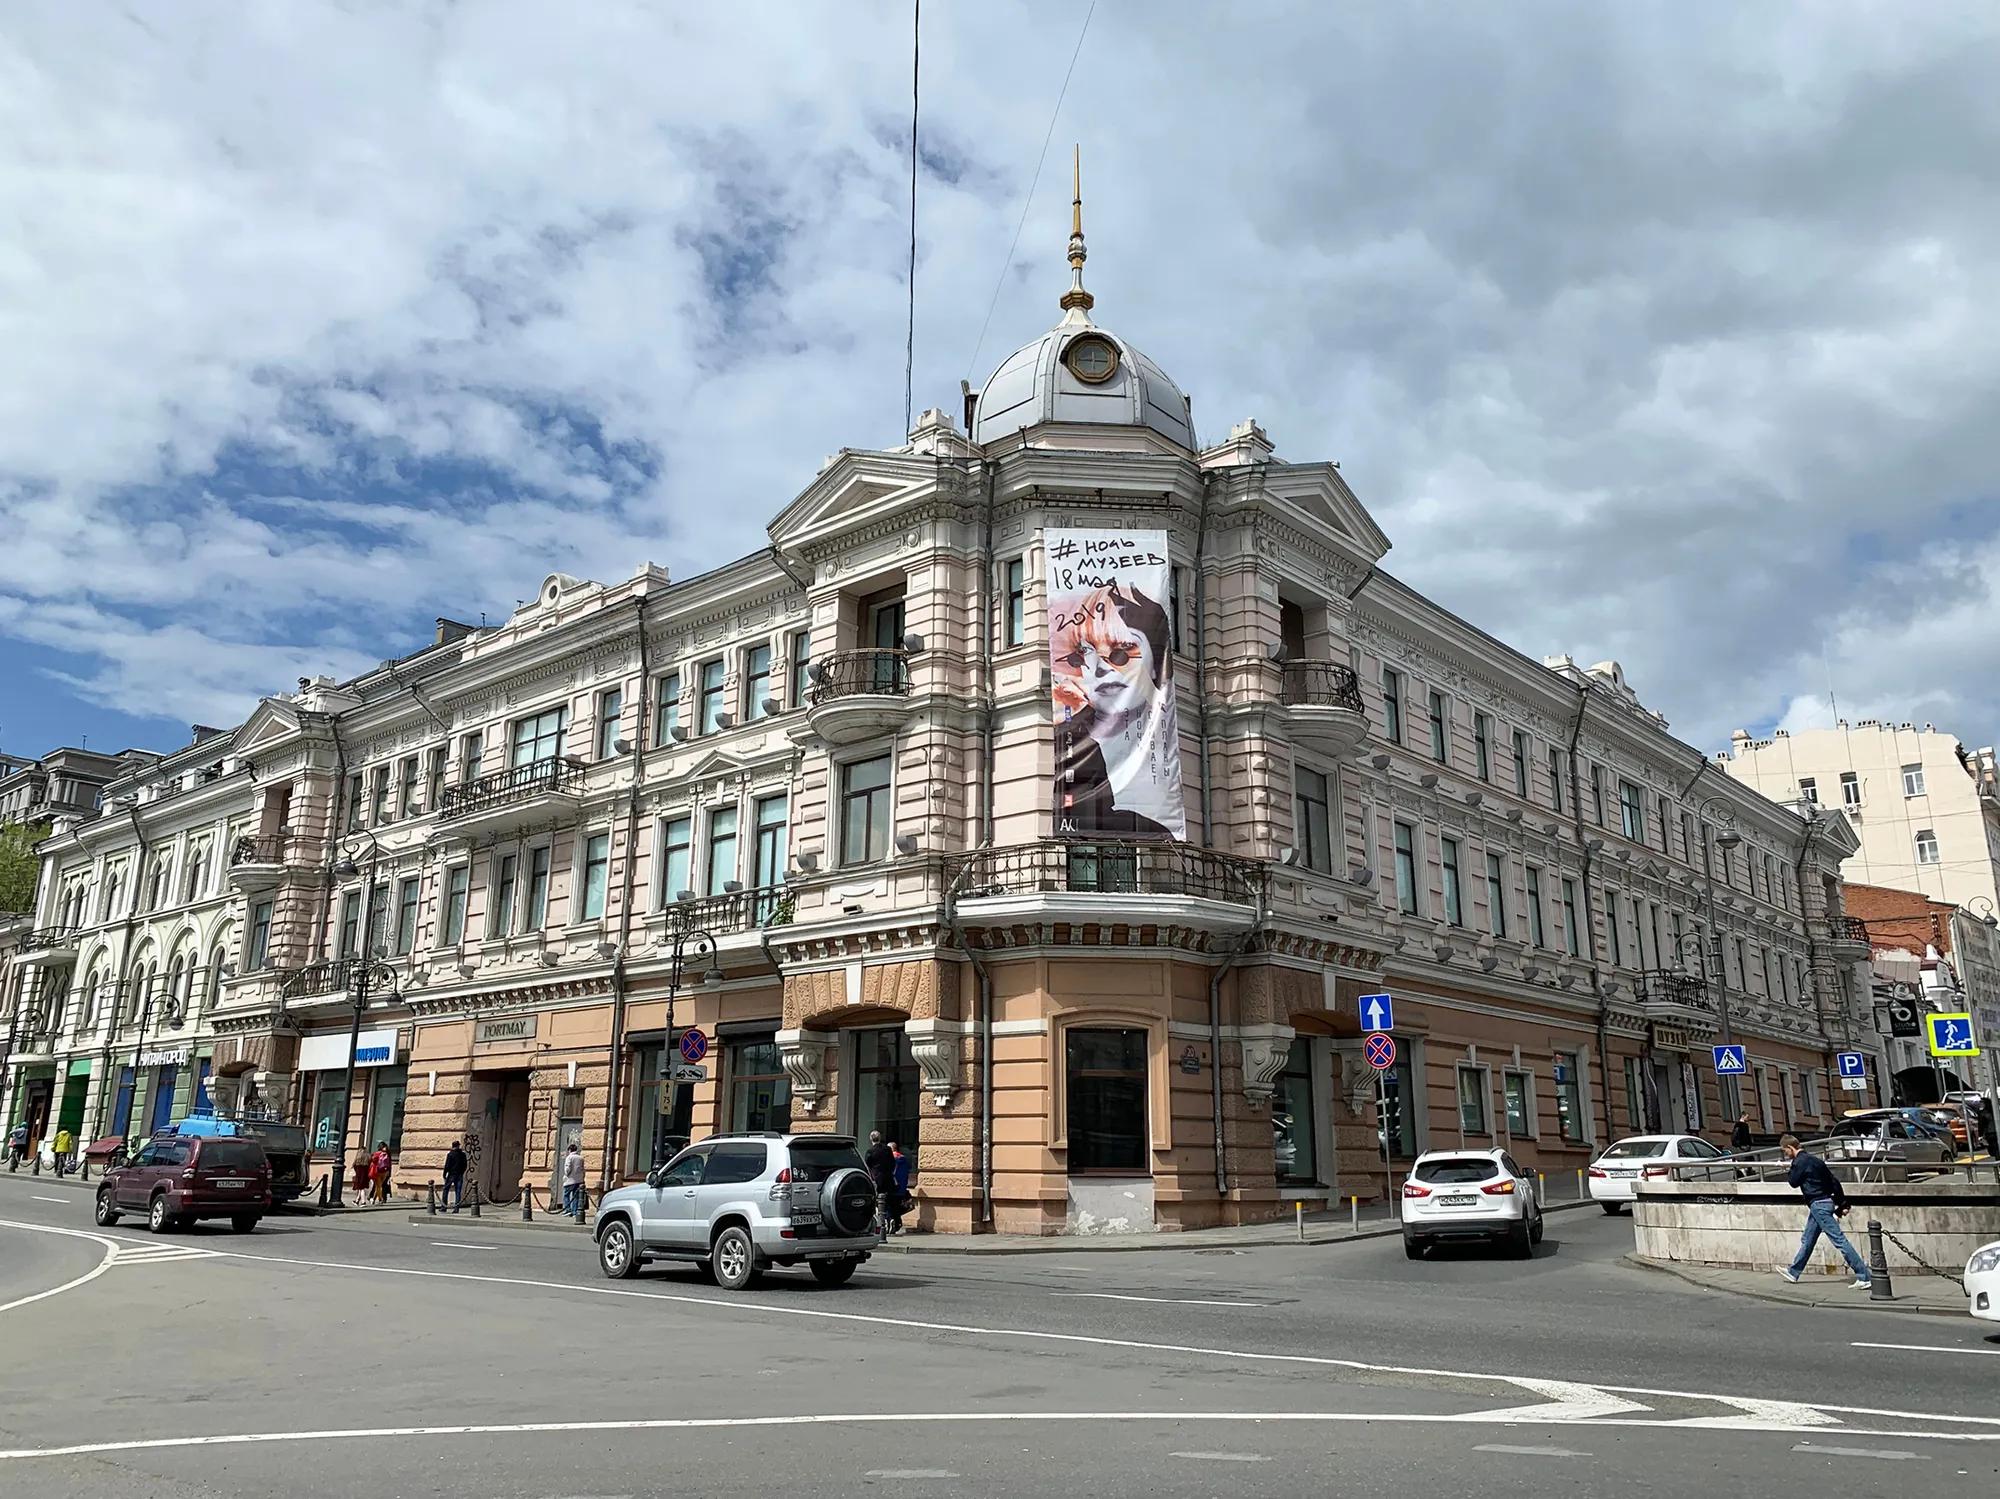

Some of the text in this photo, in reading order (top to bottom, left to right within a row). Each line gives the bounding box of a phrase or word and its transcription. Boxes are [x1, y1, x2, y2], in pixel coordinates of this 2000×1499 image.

[1077, 552, 1166, 570] МУЗЕЕВ
[1054, 567, 1073, 590] 18
[1055, 602, 1105, 632] 2019
[484, 1021, 526, 1038] PORTMAY
[663, 1096, 671, 1104] 75
